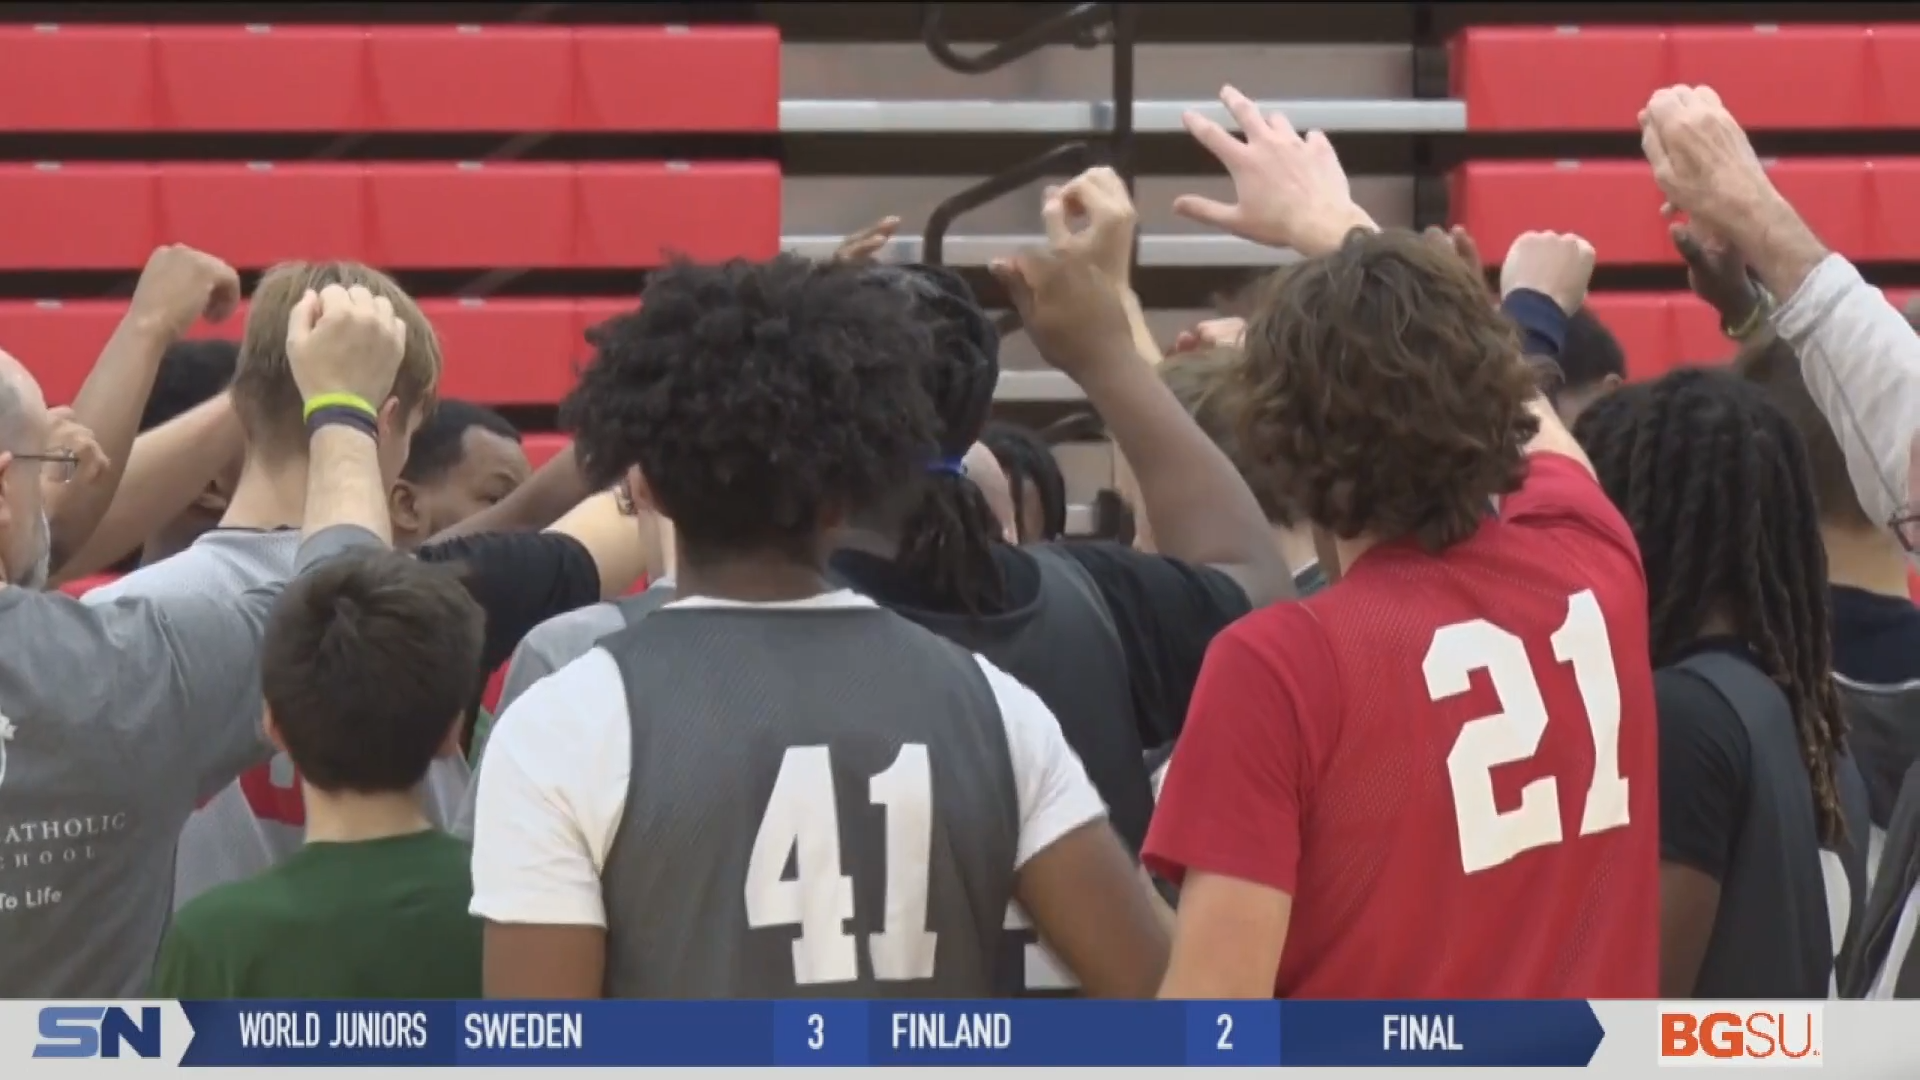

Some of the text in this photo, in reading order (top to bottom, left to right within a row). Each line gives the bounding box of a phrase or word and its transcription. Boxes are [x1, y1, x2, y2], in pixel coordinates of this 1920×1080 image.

[1421, 588, 1631, 875] 21
[25, 886, 62, 909] Life
[744, 743, 938, 985] 41
